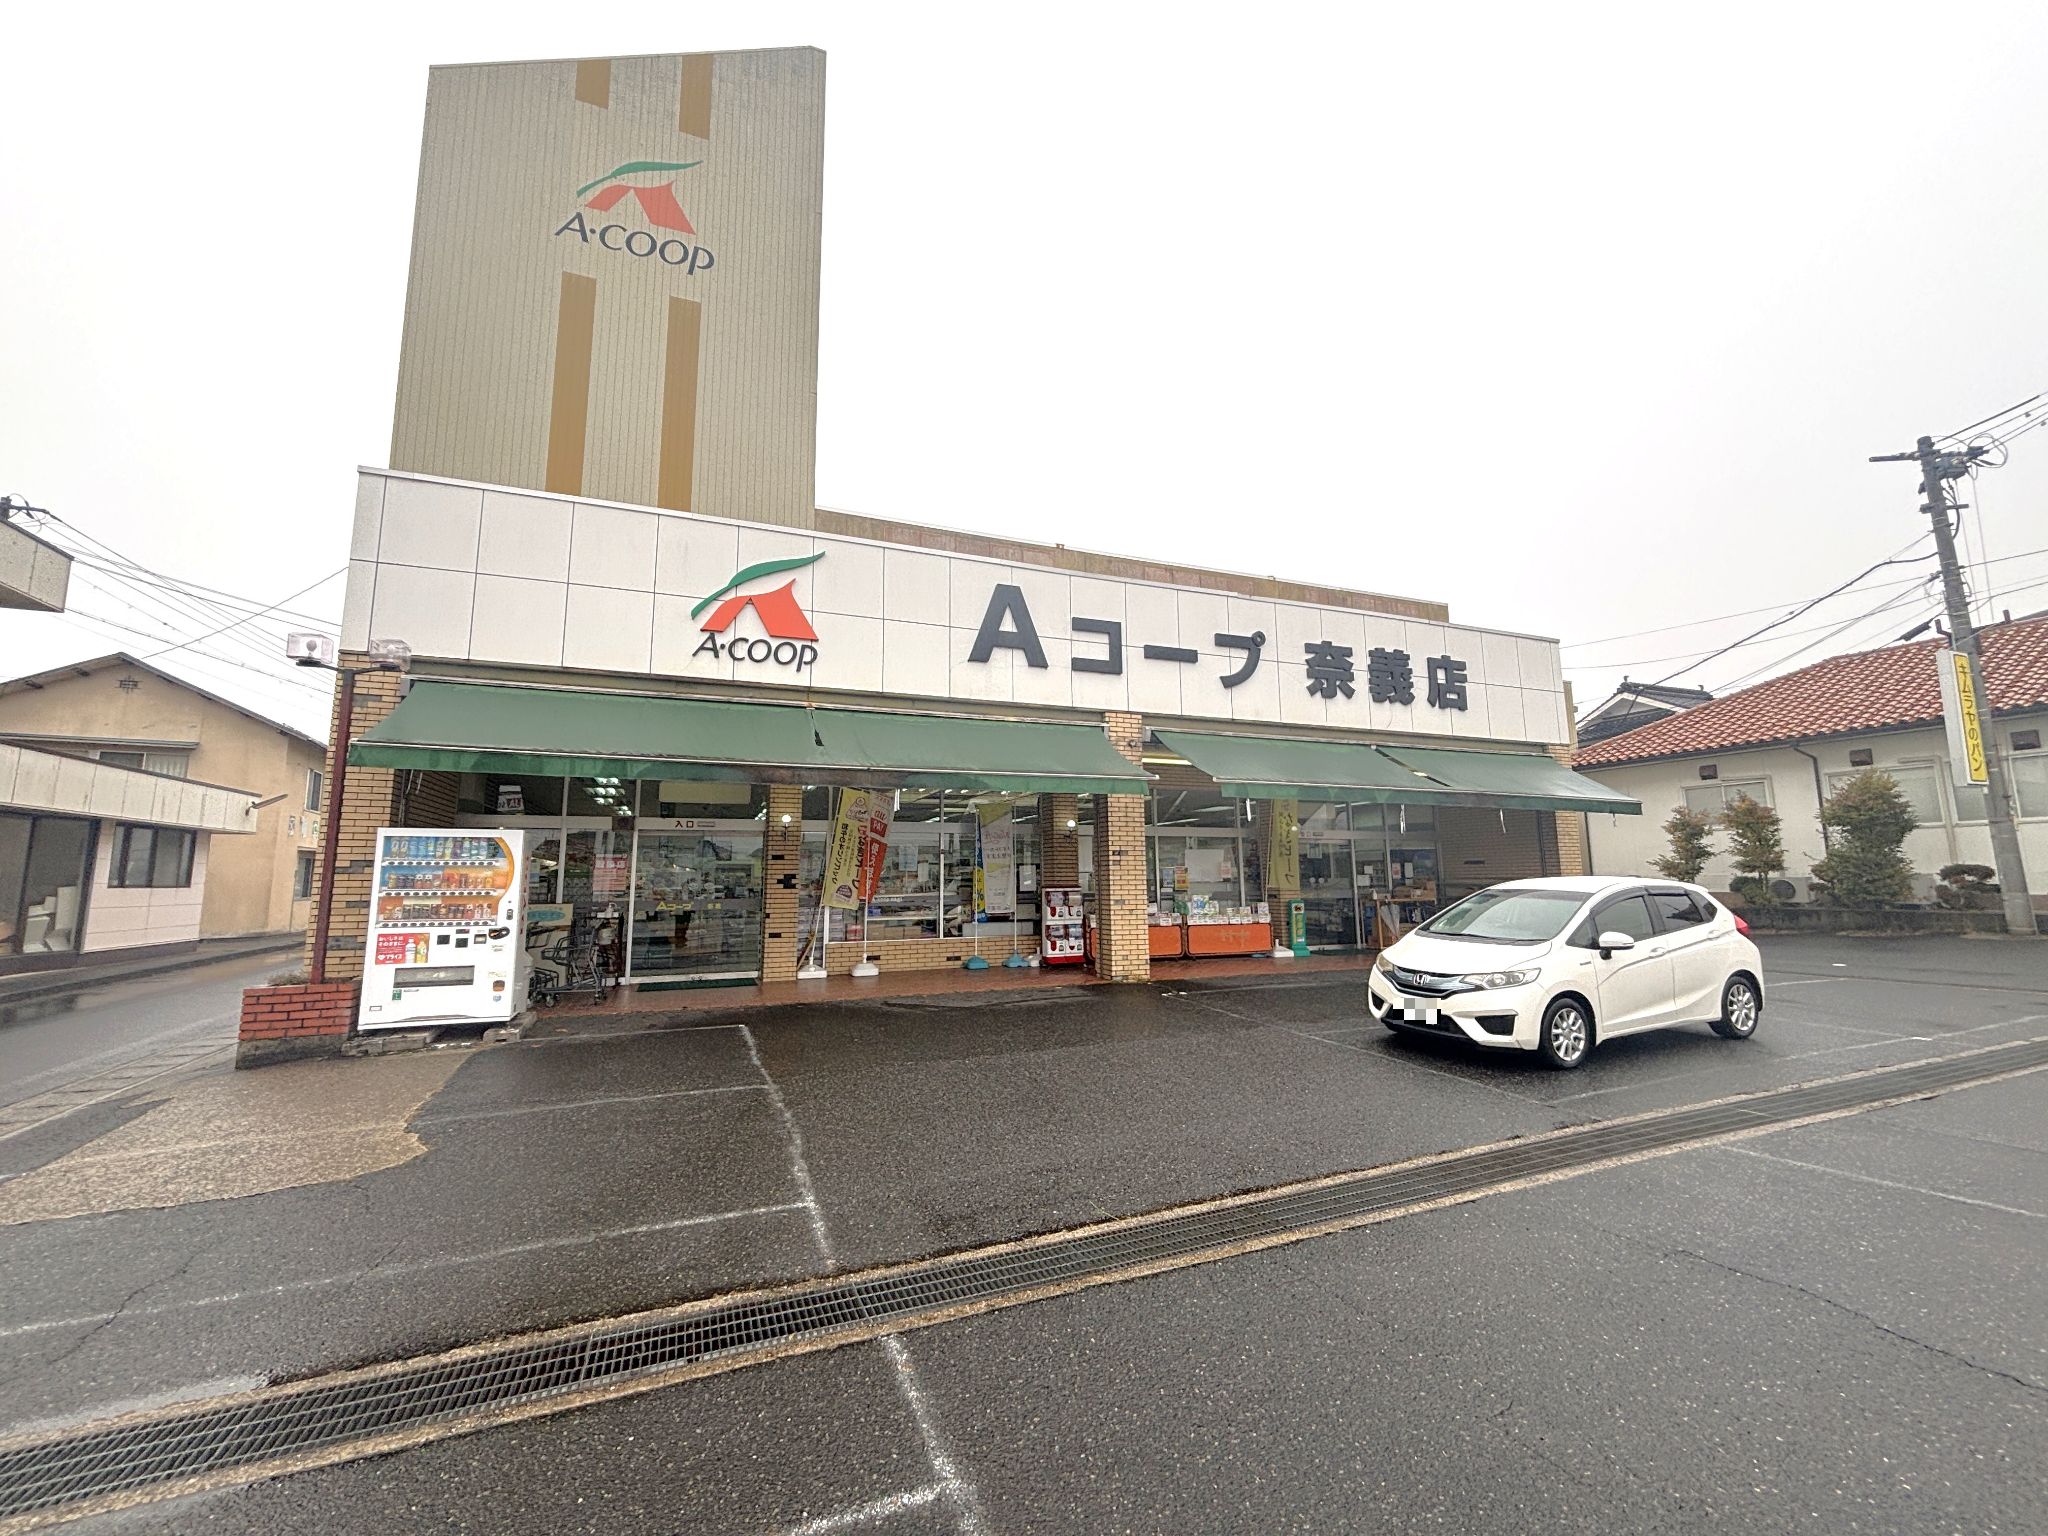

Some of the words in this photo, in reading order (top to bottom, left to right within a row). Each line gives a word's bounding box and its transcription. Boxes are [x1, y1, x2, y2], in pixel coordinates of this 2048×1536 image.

[968, 583, 1266, 688] Aコープ
[1304, 640, 1468, 711] 奈義店
[1958, 664, 1983, 772] キムラヤのパン
[675, 820, 694, 828] 入口
